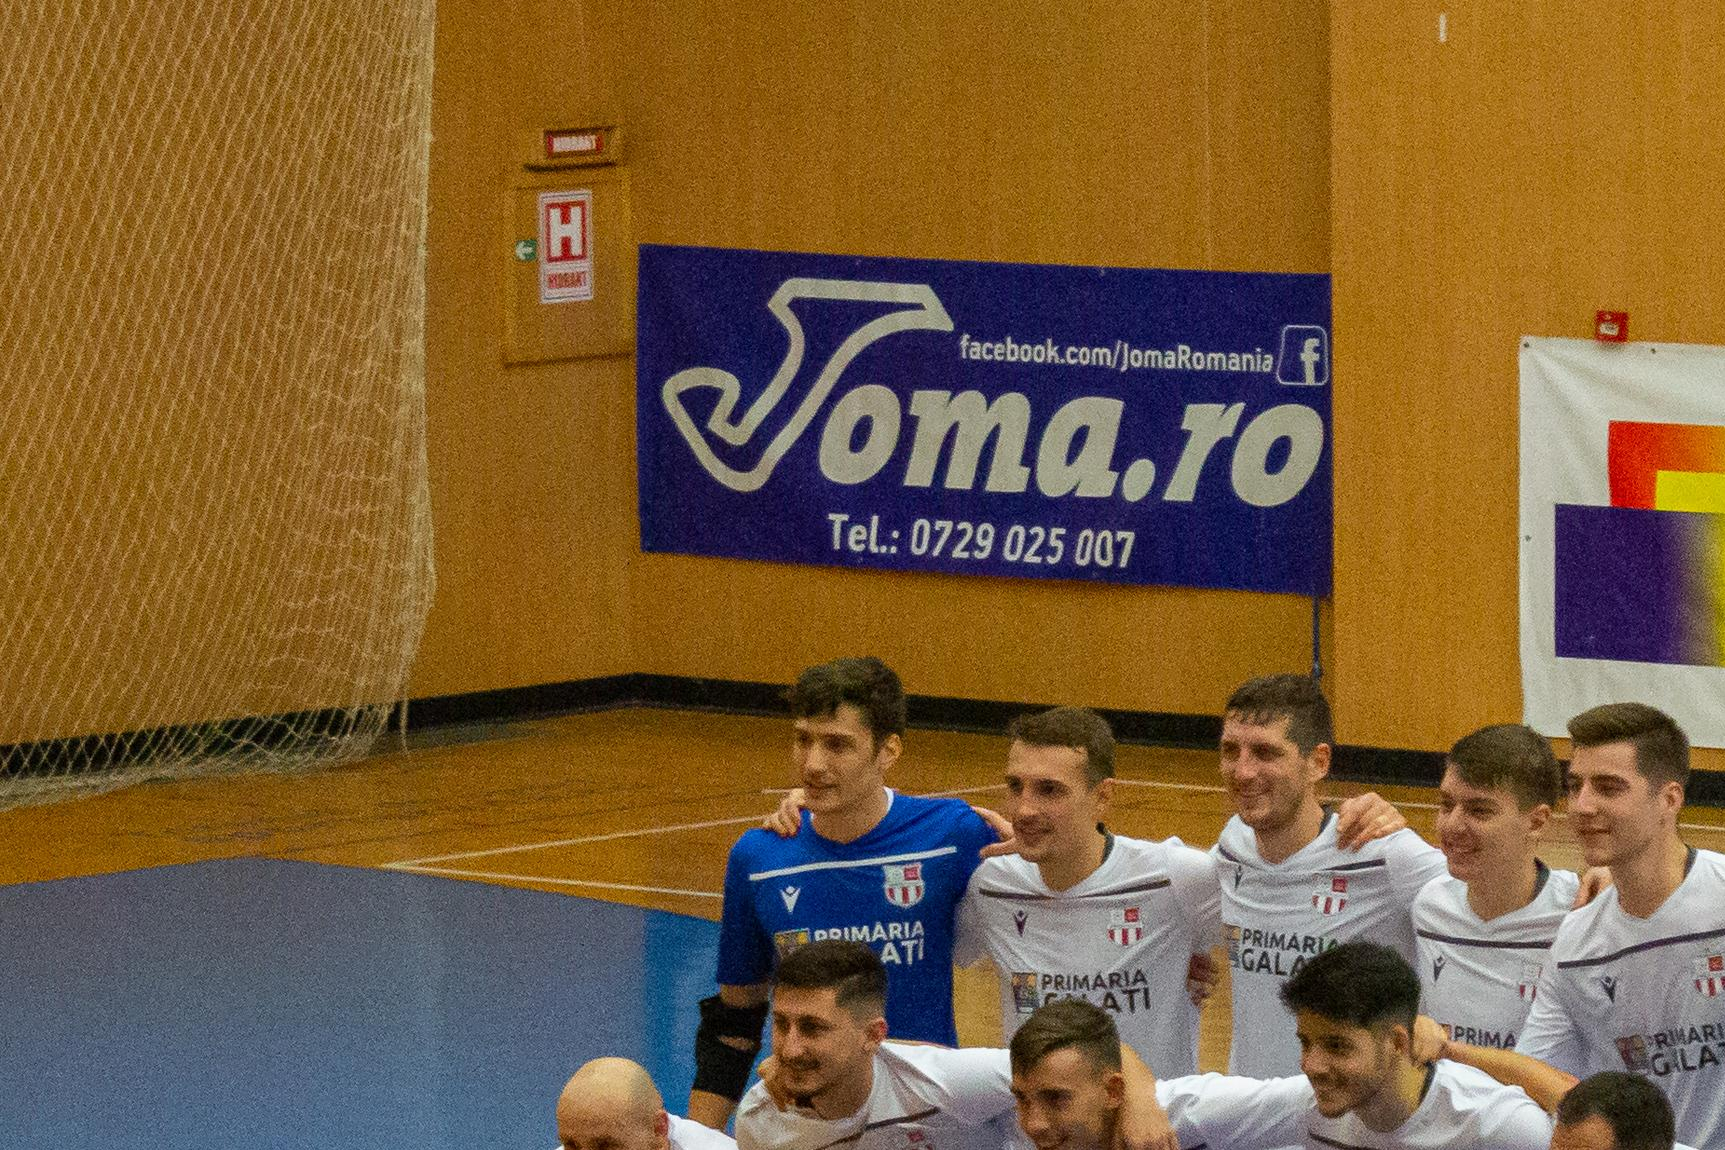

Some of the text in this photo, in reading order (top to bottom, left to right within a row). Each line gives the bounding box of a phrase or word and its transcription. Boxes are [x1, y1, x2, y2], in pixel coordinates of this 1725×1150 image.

[549, 207, 583, 257] H
[960, 336, 1274, 374] facebook.com/JomaRomania
[828, 515, 1136, 569] Tel.: 0729 025 007
[814, 920, 925, 943] PRIMARIA
[1041, 968, 1149, 991] PRIMARIA
